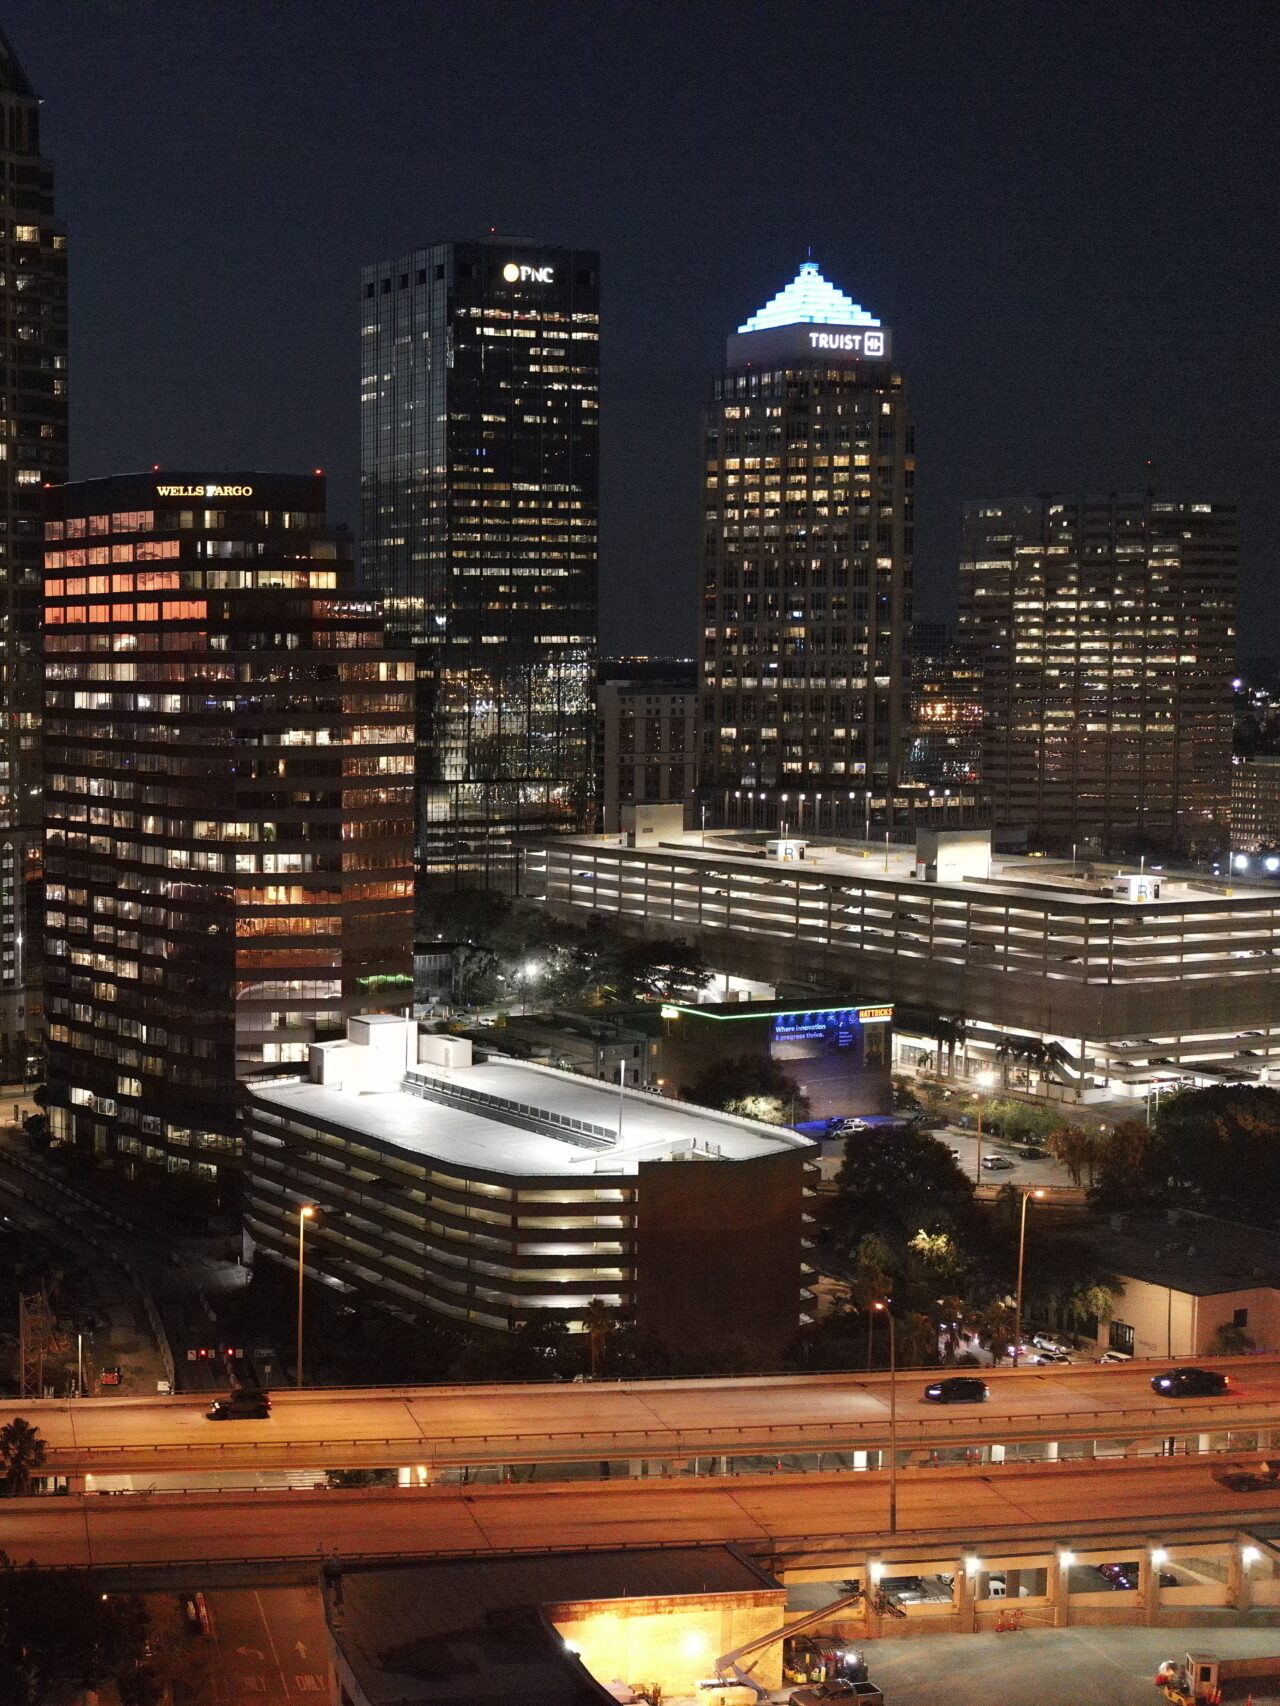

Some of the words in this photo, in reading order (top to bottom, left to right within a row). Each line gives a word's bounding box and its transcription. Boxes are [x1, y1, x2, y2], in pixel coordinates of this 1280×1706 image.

[520, 265, 554, 283] PNC
[809, 332, 862, 350] TRUIST
[157, 486, 204, 496] WELLS
[206, 485, 253, 496] FARGO
[859, 1008, 893, 1018] HATTRICKS
[795, 1023, 826, 1032] innovation
[295, 1674, 326, 1691] ONLY
